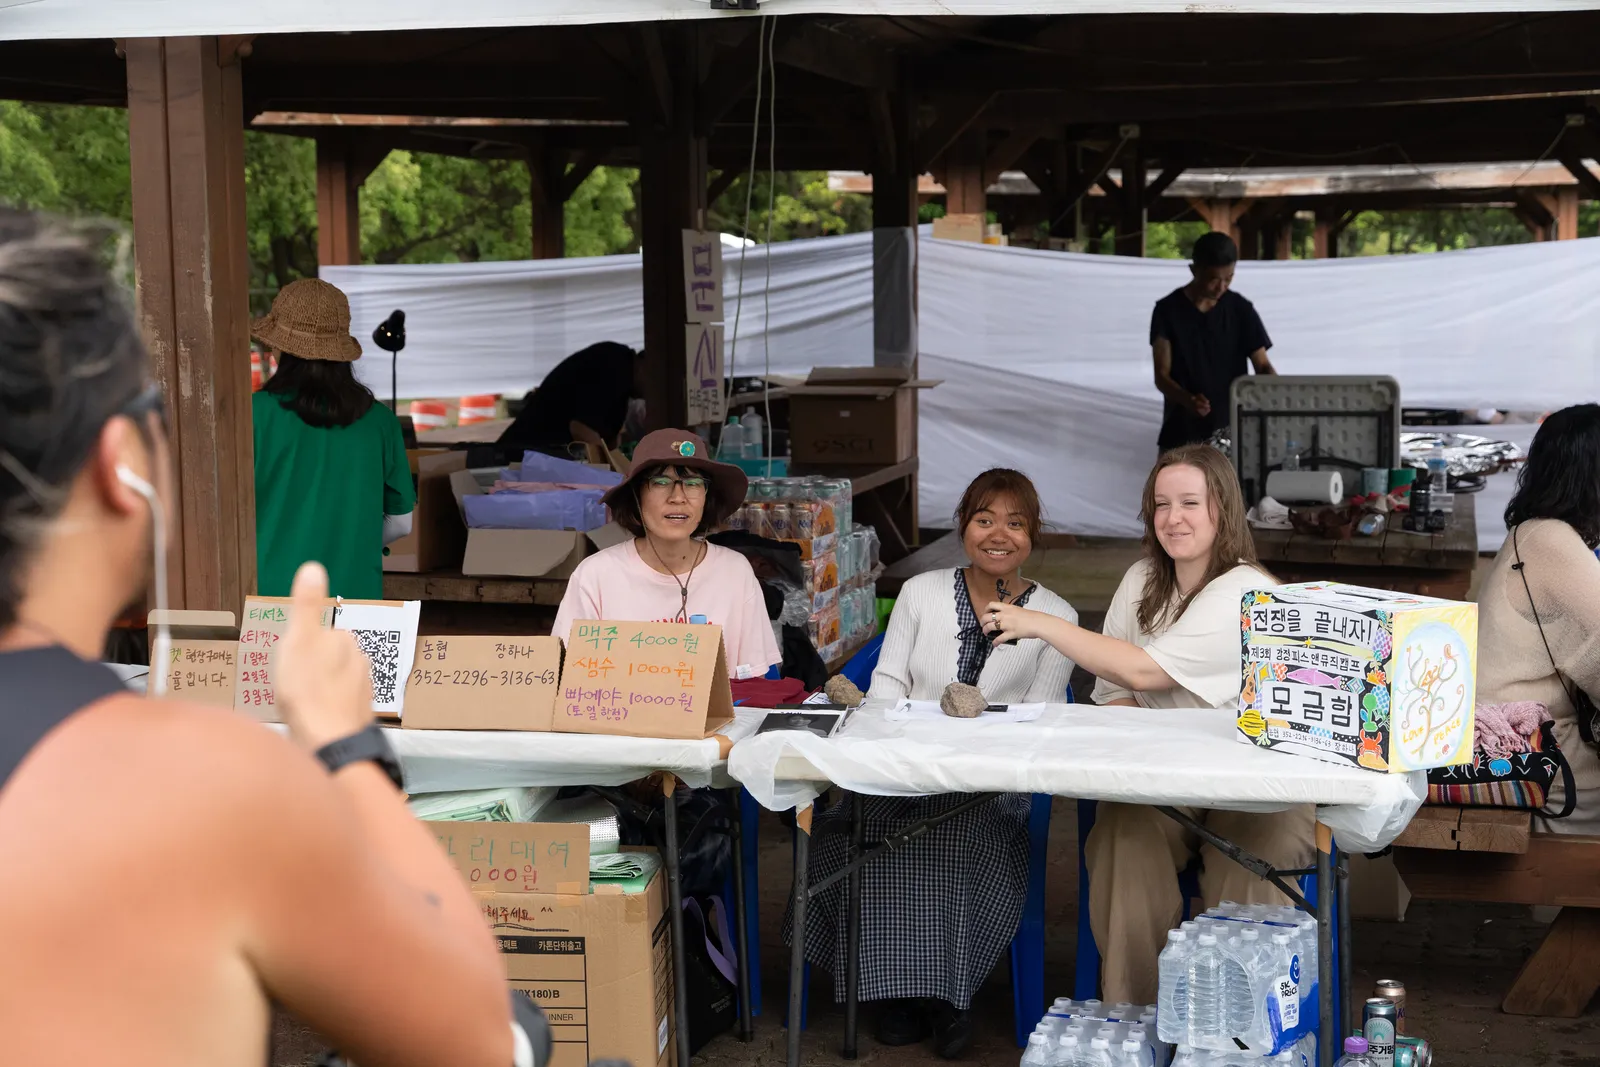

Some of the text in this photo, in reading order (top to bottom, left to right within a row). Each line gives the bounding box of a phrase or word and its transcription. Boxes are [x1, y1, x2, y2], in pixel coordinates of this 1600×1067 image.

[249, 607, 287, 622] 티셔츠
[1253, 608, 1373, 645] 전쟁을 끝내자!
[240, 630, 279, 648] <티켓>
[578, 625, 618, 651] 맥주
[185, 648, 234, 666] 현장구매는
[422, 640, 534, 660] 농협 장하나
[1251, 647, 1272, 661] 제3회
[572, 656, 615, 678] 생수
[166, 670, 229, 691] 율입니다.
[242, 669, 271, 685] 2일권
[413, 669, 555, 686] 352-2296-3136-63
[242, 688, 275, 706] 3일권
[565, 687, 622, 707] 빠에야
[1269, 686, 1353, 728] 모금함
[1402, 716, 1462, 745] LOVE PEACE
[538, 940, 583, 952] 카톤단위출고
[548, 1013, 574, 1021] INNER
